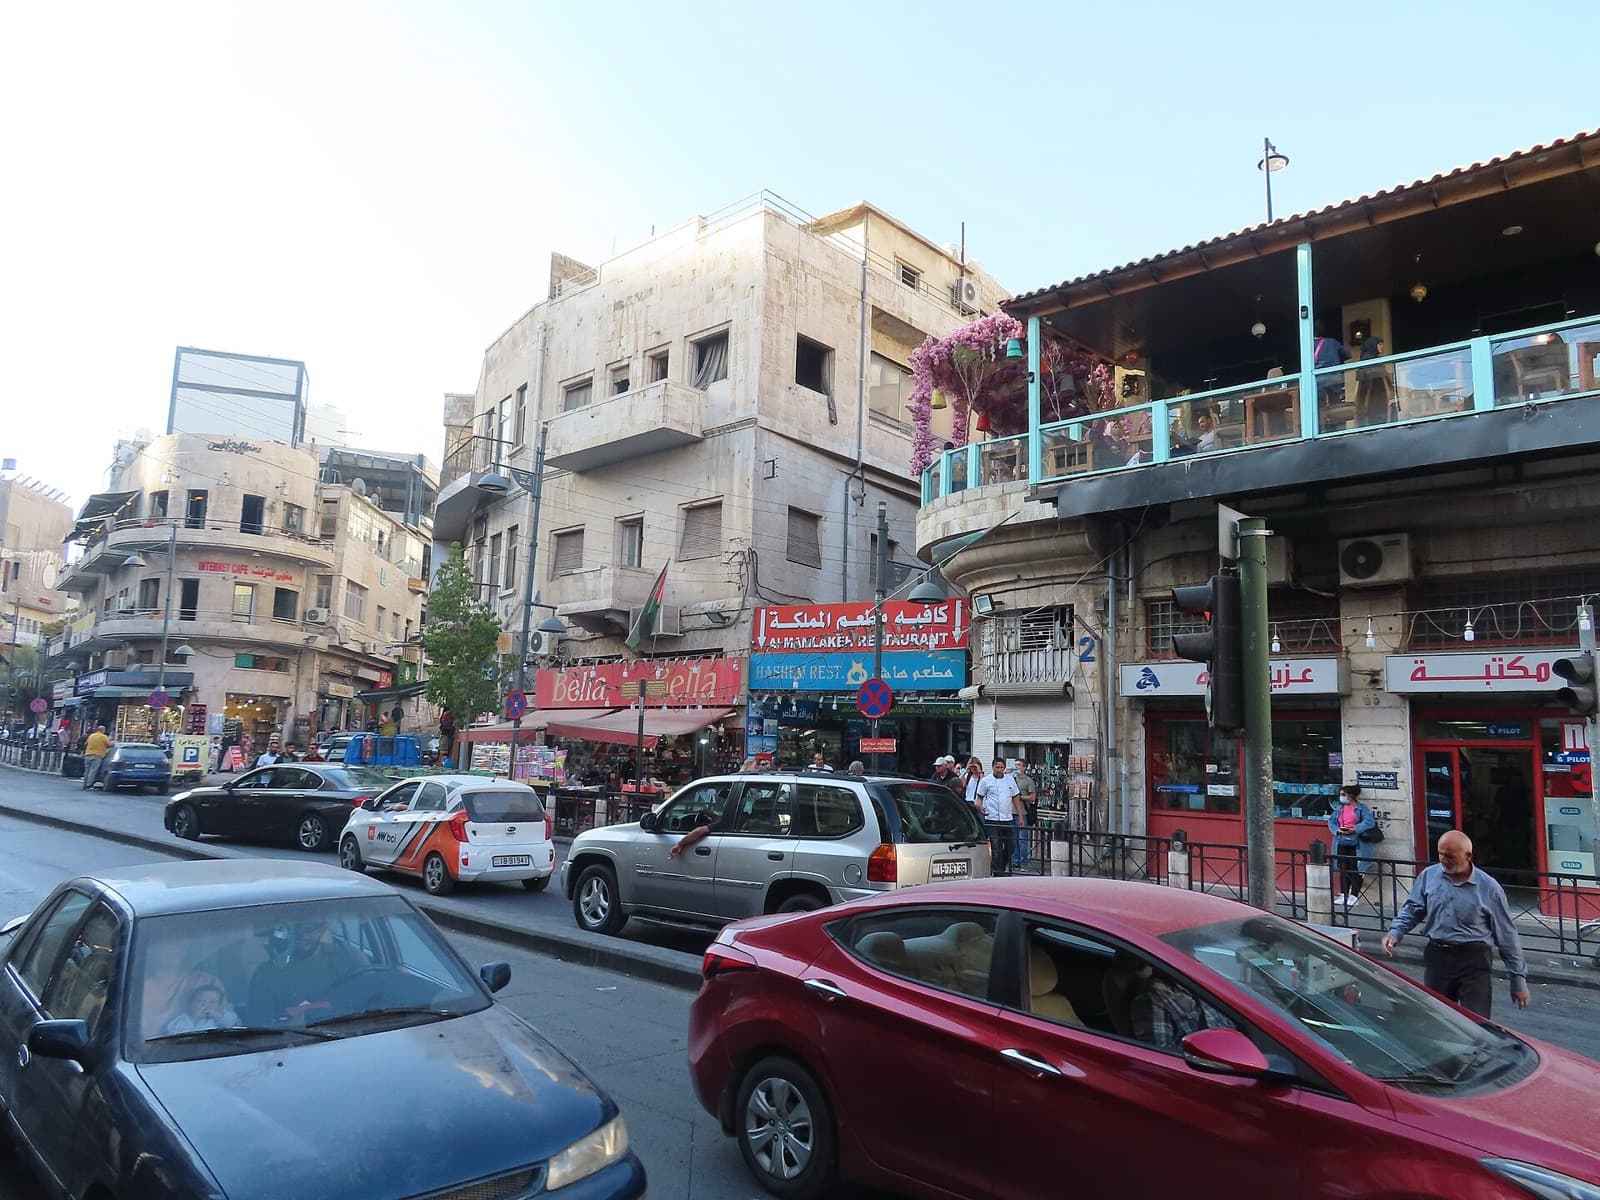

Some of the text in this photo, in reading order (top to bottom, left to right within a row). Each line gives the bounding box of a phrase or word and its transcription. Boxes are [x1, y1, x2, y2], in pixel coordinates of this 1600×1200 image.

[198, 561, 249, 575] INTERNET CAFE
[894, 604, 949, 629] كافيه
[1079, 636, 1096, 663] 2
[756, 665, 845, 681] HASHEM REST.
[871, 665, 908, 679] هاش
[1410, 655, 1550, 686] مكتبة
[552, 671, 607, 703] Bella
[185, 748, 198, 761] P
